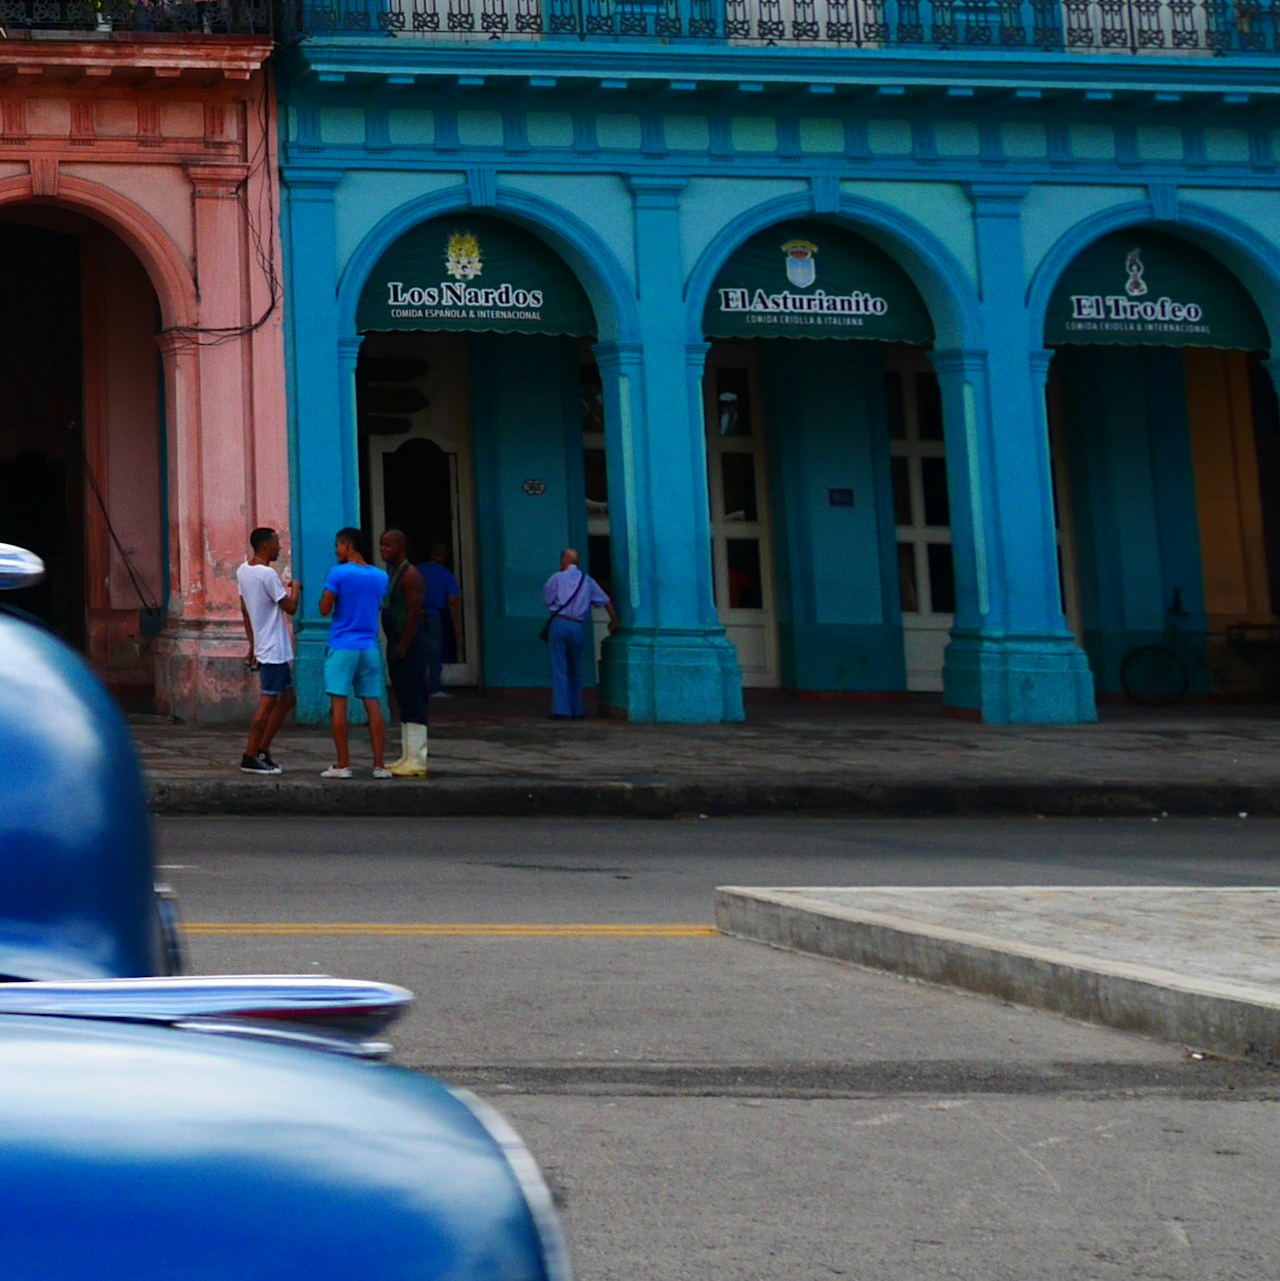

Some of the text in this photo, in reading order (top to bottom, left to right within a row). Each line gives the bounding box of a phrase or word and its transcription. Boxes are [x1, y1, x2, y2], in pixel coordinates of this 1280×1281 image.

[387, 282, 544, 307] Los Nardos
[718, 288, 888, 315] El Asturianito
[391, 307, 542, 320] COMIDA ESPAÑOLA & INTERNACIONAL
[1070, 295, 1202, 322] El Trofeo
[746, 315, 864, 326] COMIDA CRIOLLA & ITALIANA
[1066, 322, 1210, 334] COMIDA CRIOLLA & INTERNACIONAL
